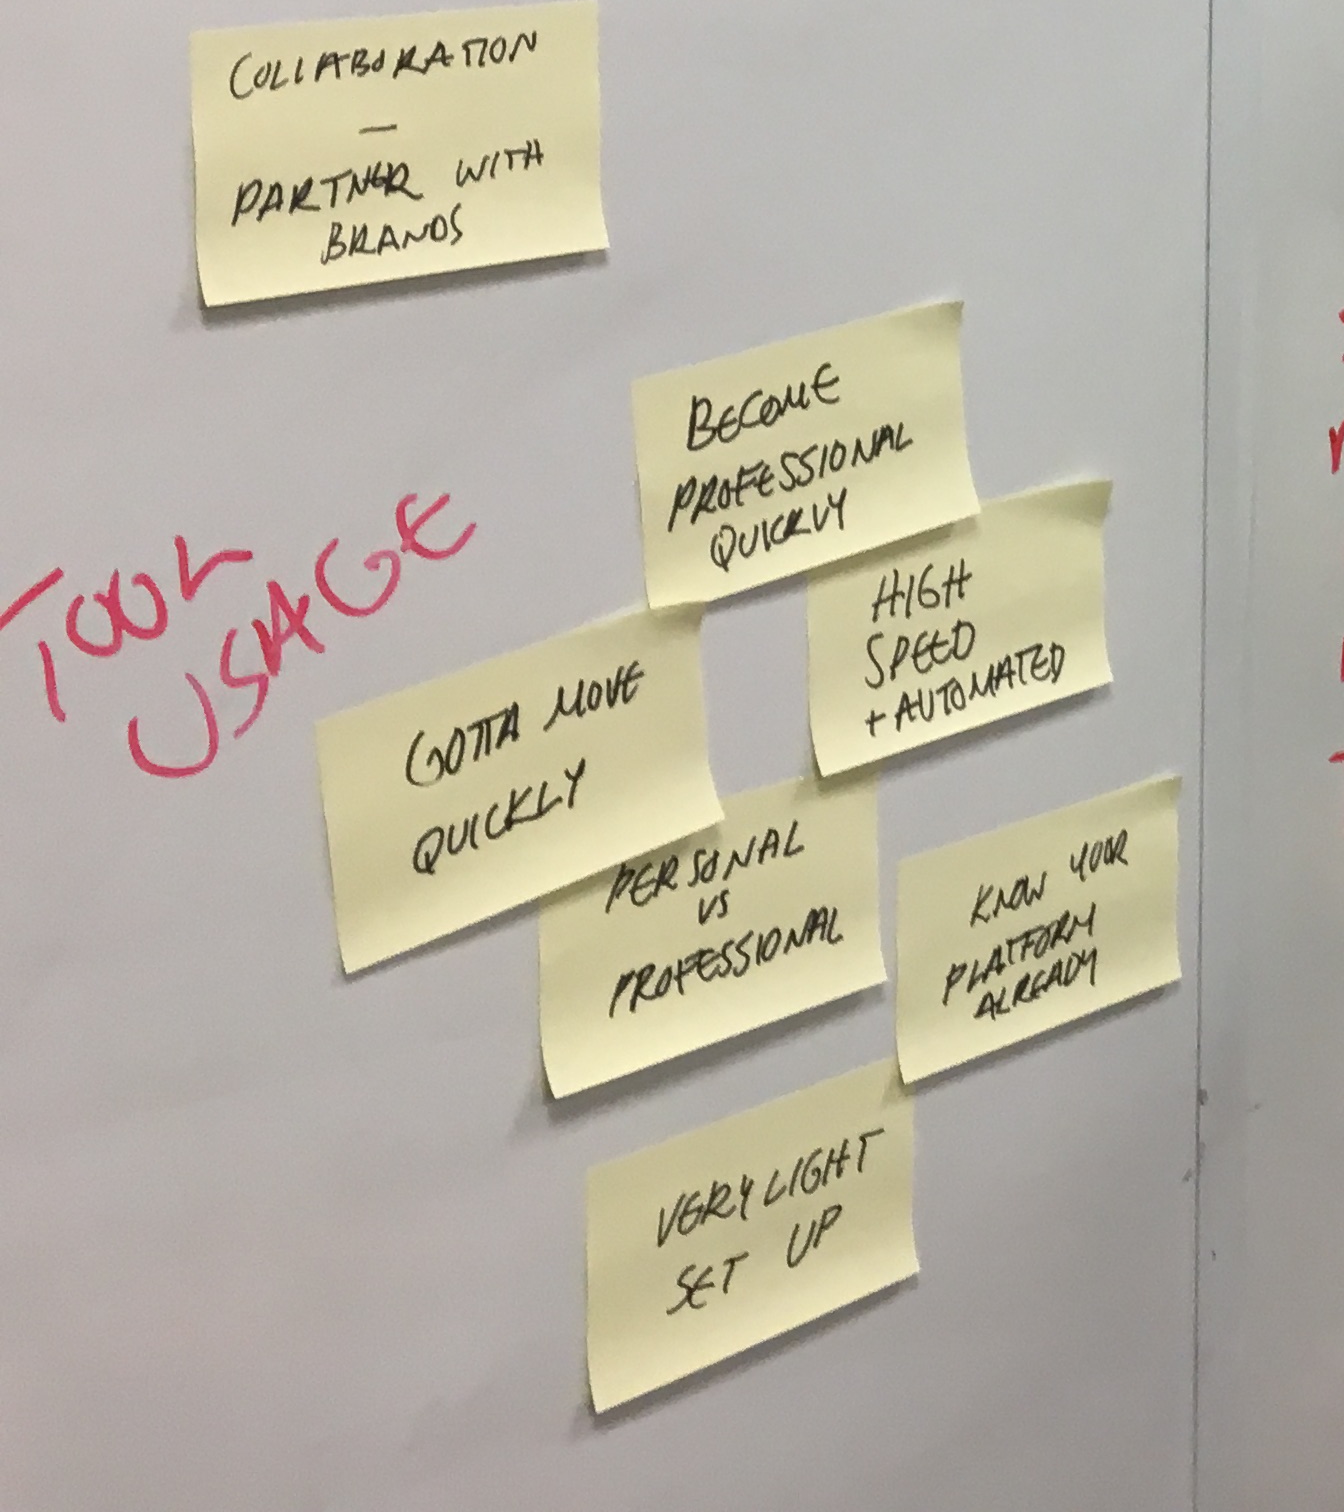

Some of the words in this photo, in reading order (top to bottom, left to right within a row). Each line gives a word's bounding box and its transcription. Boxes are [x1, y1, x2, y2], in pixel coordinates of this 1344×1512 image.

[229, 29, 539, 101] COLLABORATION
[231, 160, 424, 227] PARTNER
[455, 138, 545, 187] WITH
[319, 203, 464, 265] BRANDS
[686, 362, 841, 452] BECOME
[667, 421, 913, 533] PROFESSIONAL
[709, 487, 849, 573] QUICKLY
[0, 535, 254, 723] TOOL
[127, 493, 477, 780] USAGE
[871, 557, 973, 622] HIGH
[864, 619, 977, 689] SPEED
[405, 701, 520, 787] GOTTA
[542, 660, 645, 732] MOVE
[411, 758, 588, 876] QUICKLY
[605, 820, 805, 913] PERSONAL
[697, 889, 730, 924] VS
[969, 870, 1047, 927] KNOW
[1068, 828, 1130, 884] YOUR
[608, 906, 844, 1018] PROFESSIONAL
[942, 903, 1096, 1006] PLATFORM
[972, 946, 1098, 1021] ALREADY
[656, 1174, 756, 1248] VERY
[762, 1127, 887, 1209] LIGHT
[665, 1250, 750, 1316] SET
[785, 1203, 844, 1269] UP
